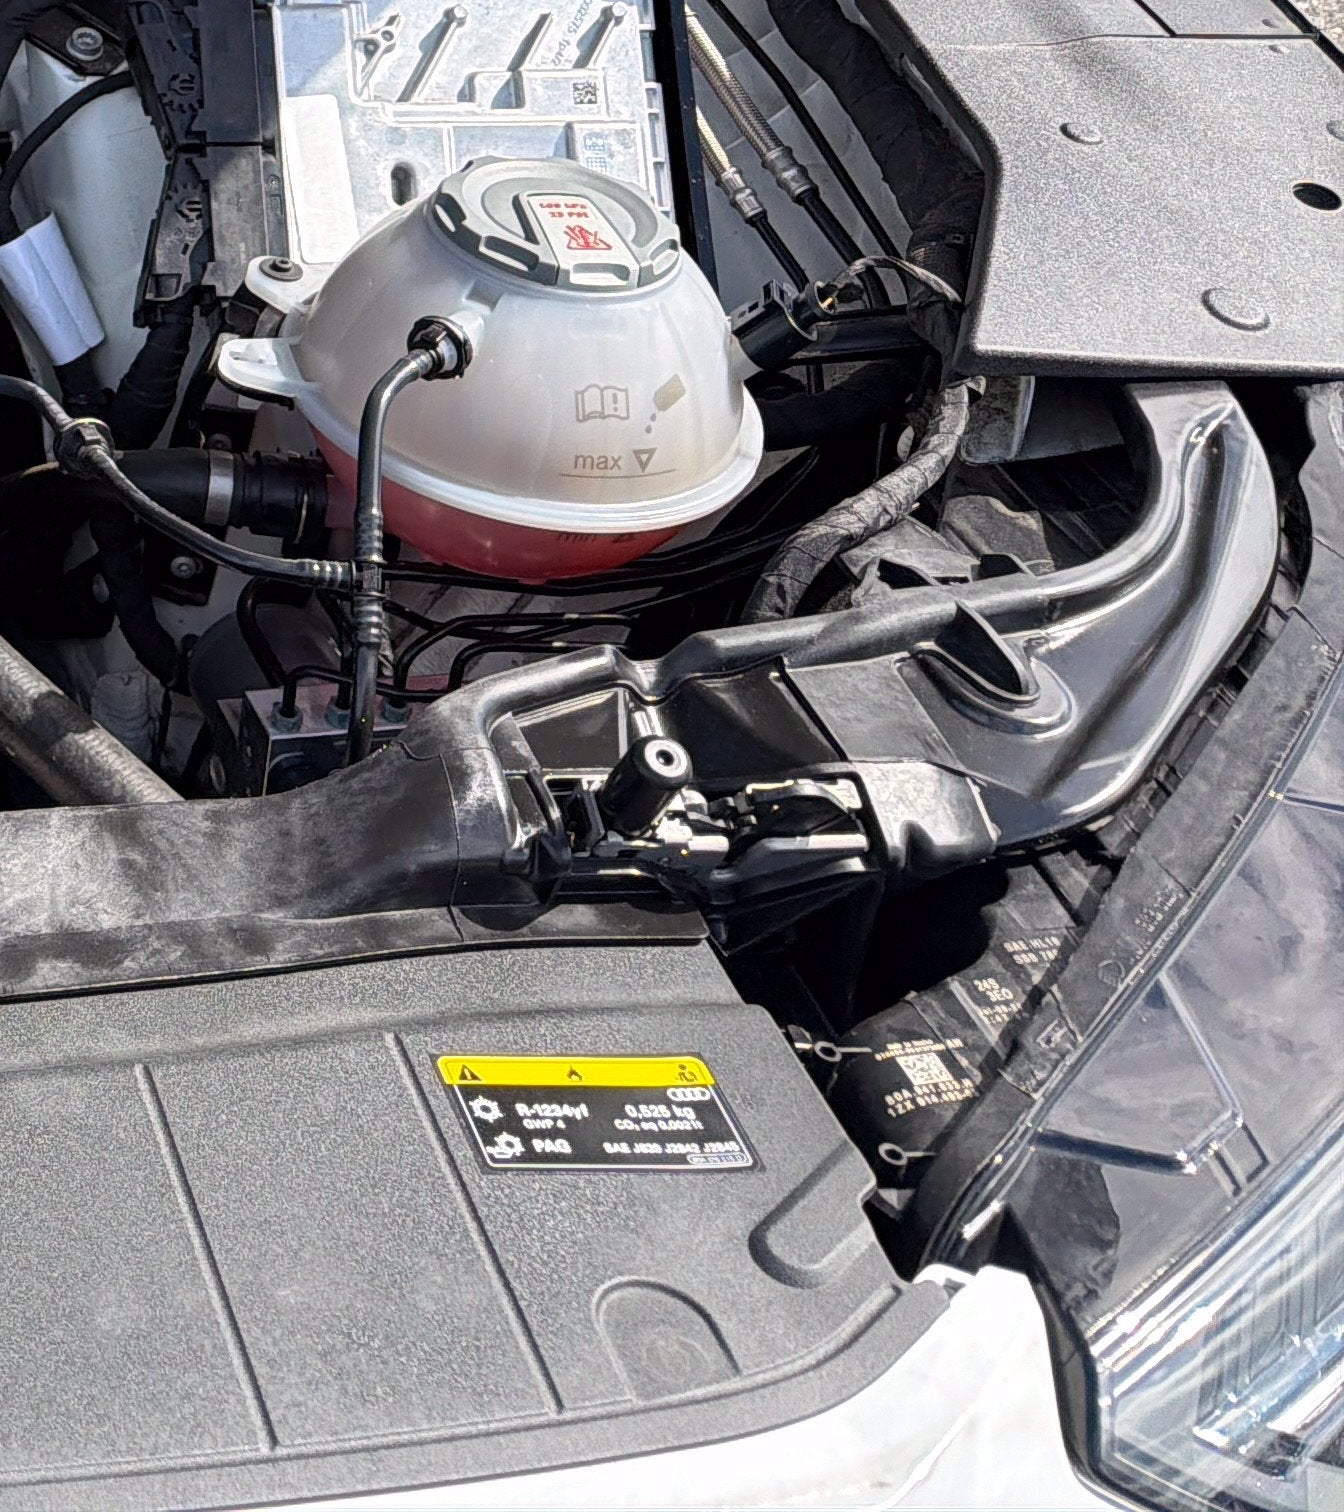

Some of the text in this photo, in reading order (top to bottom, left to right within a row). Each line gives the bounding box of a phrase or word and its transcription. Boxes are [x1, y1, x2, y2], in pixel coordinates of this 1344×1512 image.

[573, 454, 623, 470] max
[515, 1103, 589, 1120] R-1234yf
[671, 1104, 696, 1120] kg
[523, 1119, 554, 1129] GWP
[532, 1138, 572, 1154] PAG
[603, 1141, 632, 1154] SAE
